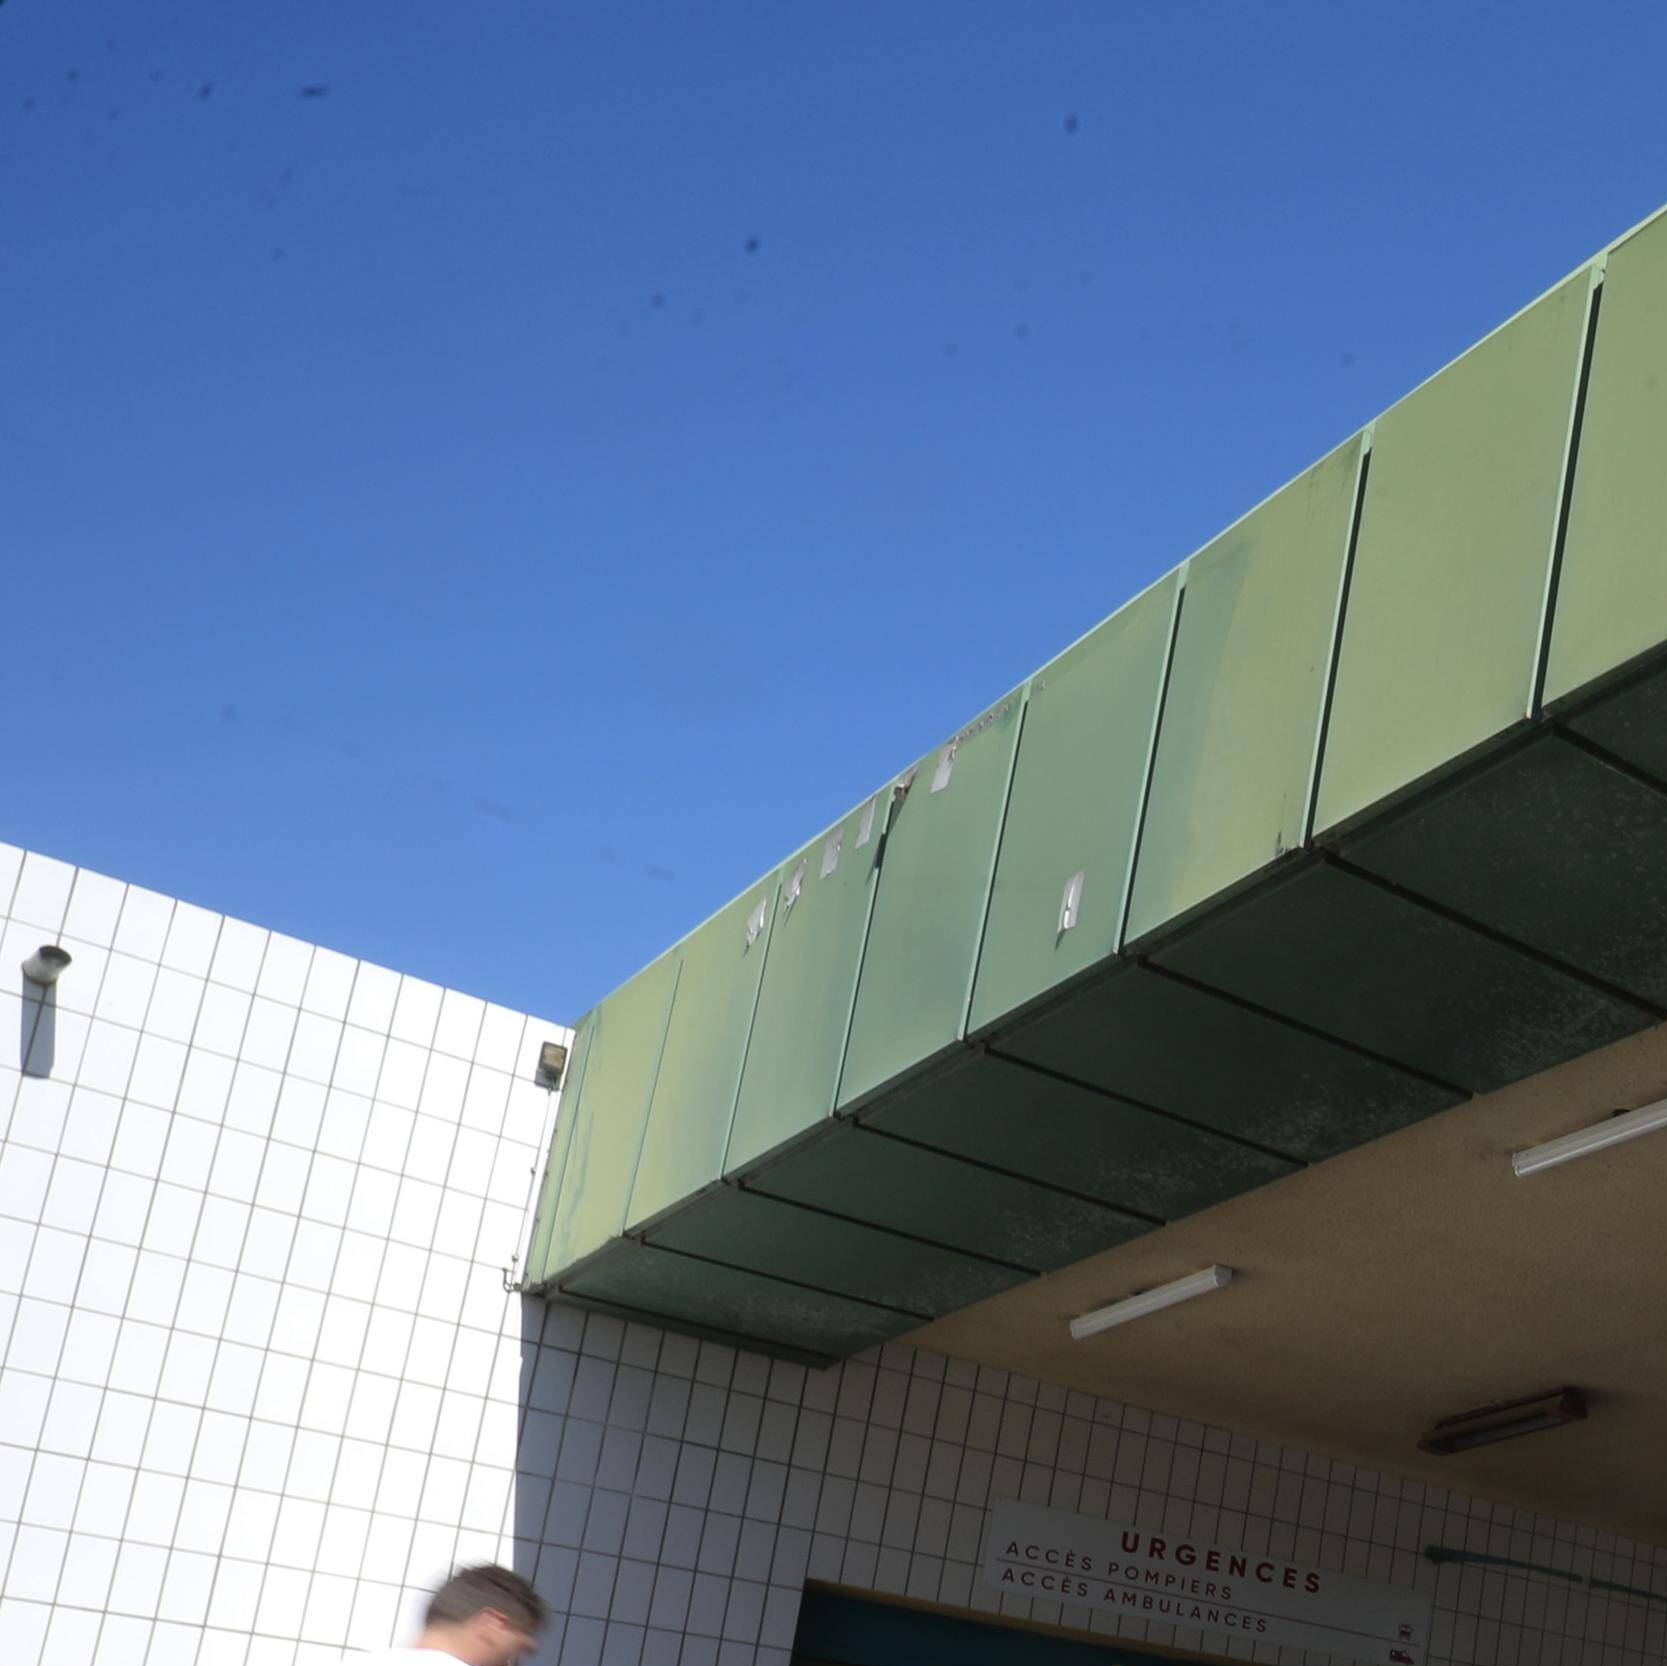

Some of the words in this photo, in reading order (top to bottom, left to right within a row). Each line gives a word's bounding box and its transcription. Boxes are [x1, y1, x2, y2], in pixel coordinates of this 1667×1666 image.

[1005, 1539, 1094, 1572] ACCÈS
[1107, 1561, 1233, 1600] POMPIERS
[1120, 1530, 1322, 1594] URGENCES
[1001, 1566, 1089, 1598] ACCÈS
[1102, 1587, 1269, 1633] AMBULANCES
